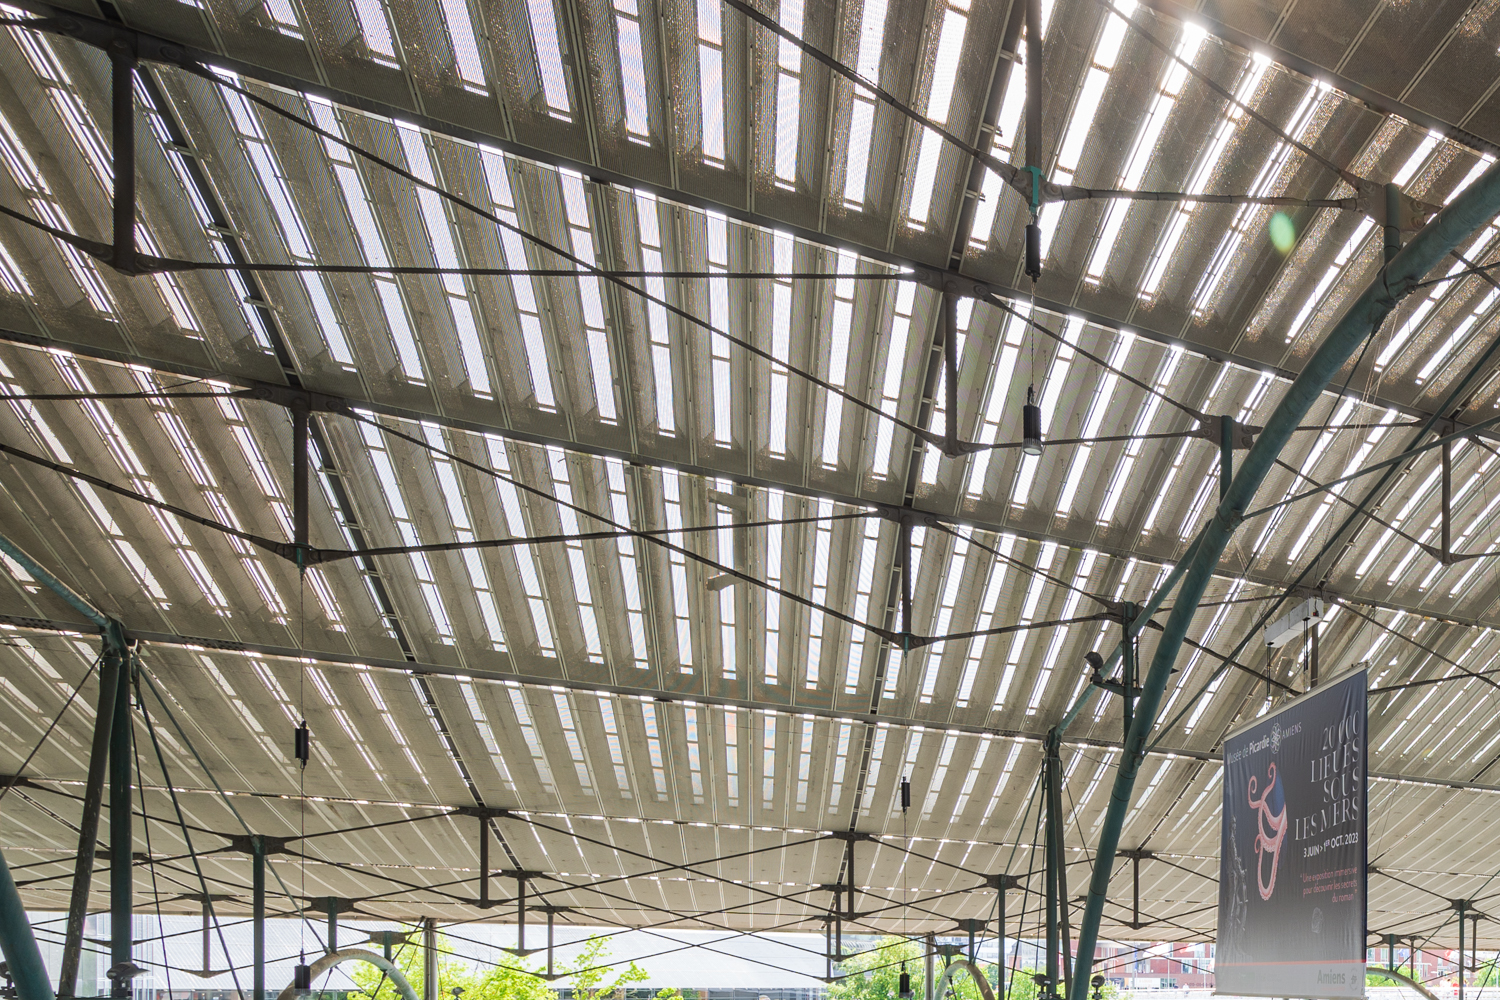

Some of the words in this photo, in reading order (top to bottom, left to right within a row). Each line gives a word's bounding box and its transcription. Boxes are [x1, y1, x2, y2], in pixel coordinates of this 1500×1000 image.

[1281, 722, 1302, 739] AMIENS
[1322, 725, 1336, 751] 20
[1227, 749, 1242, 765] Musée
[1242, 746, 1249, 758] de
[1249, 734, 1270, 756] Picardie
[1310, 737, 1360, 783] LIEUES
[1323, 766, 1360, 803] SOUS
[1295, 813, 1318, 841] LES
[1320, 797, 1359, 833] MERS
[1303, 848, 1307, 858] 3
[1307, 844, 1320, 857] JUIN
[1331, 835, 1345, 849] OCT.
[1345, 832, 1359, 845] 2023
[1332, 895, 1338, 903] du
[1339, 893, 1354, 903] roman
[1316, 969, 1346, 985] Amiens
